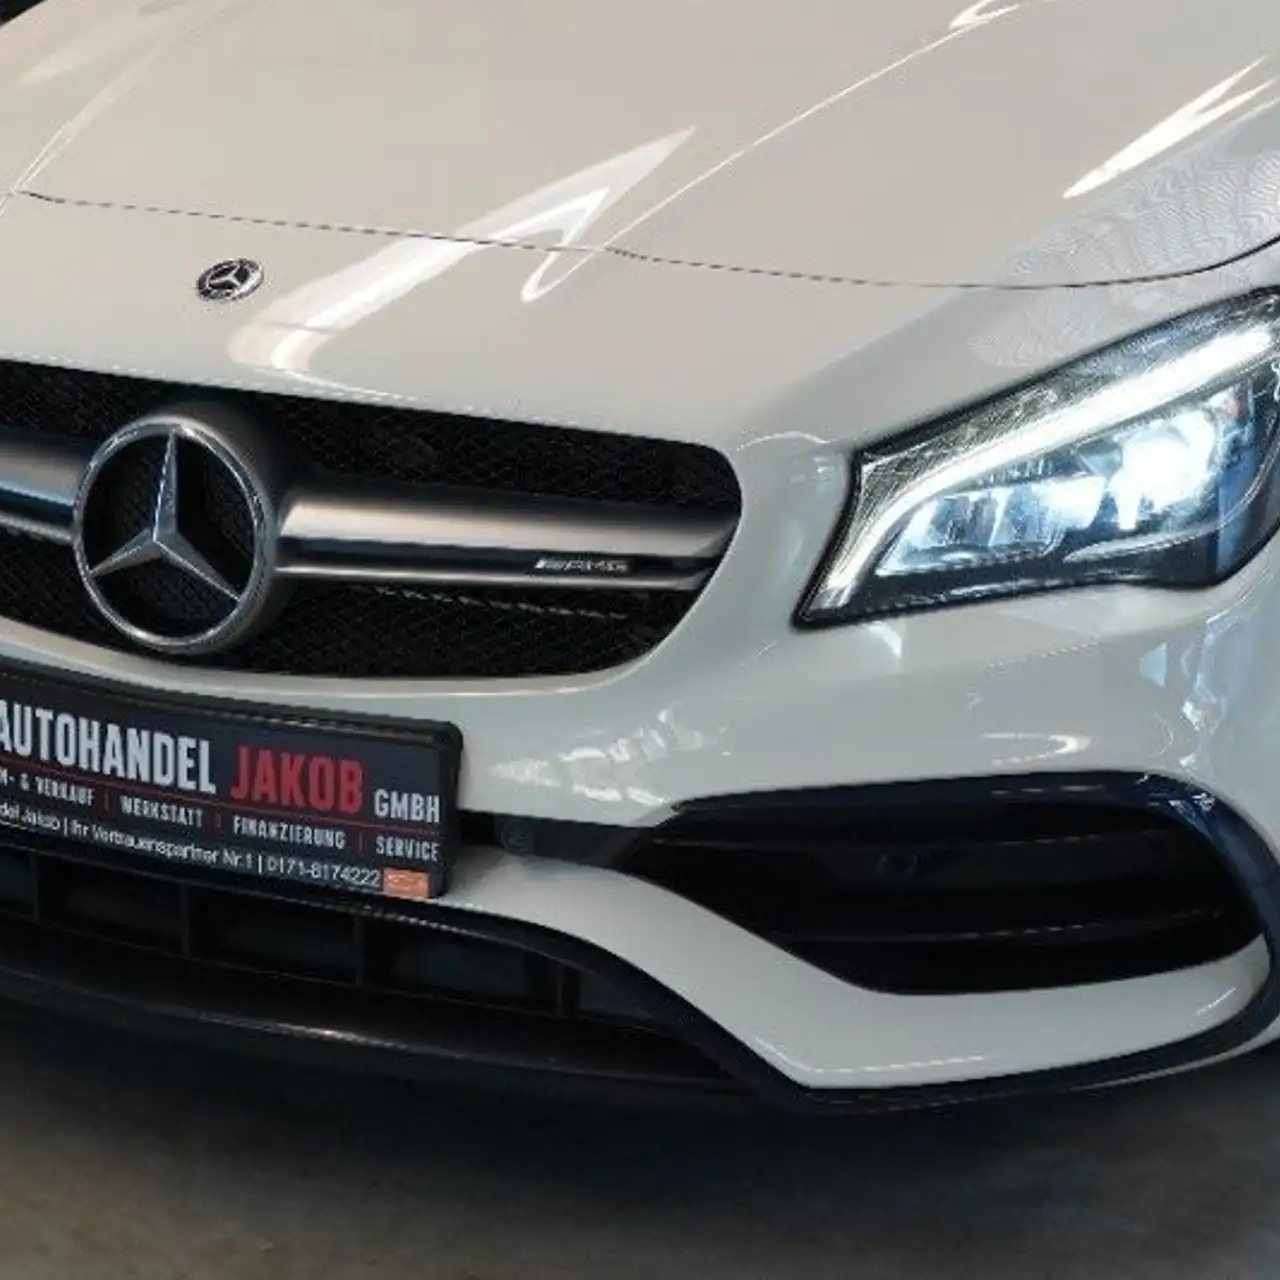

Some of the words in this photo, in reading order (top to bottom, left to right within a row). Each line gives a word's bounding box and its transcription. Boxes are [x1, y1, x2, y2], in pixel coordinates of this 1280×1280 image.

[35, 775, 95, 807] VERKAUF
[120, 795, 204, 828] WERKSTATT
[233, 815, 346, 851] FINANZIERUNG
[375, 835, 440, 862] SERVICE
[230, 744, 364, 814] JAKOB
[373, 787, 440, 824] GMBH
